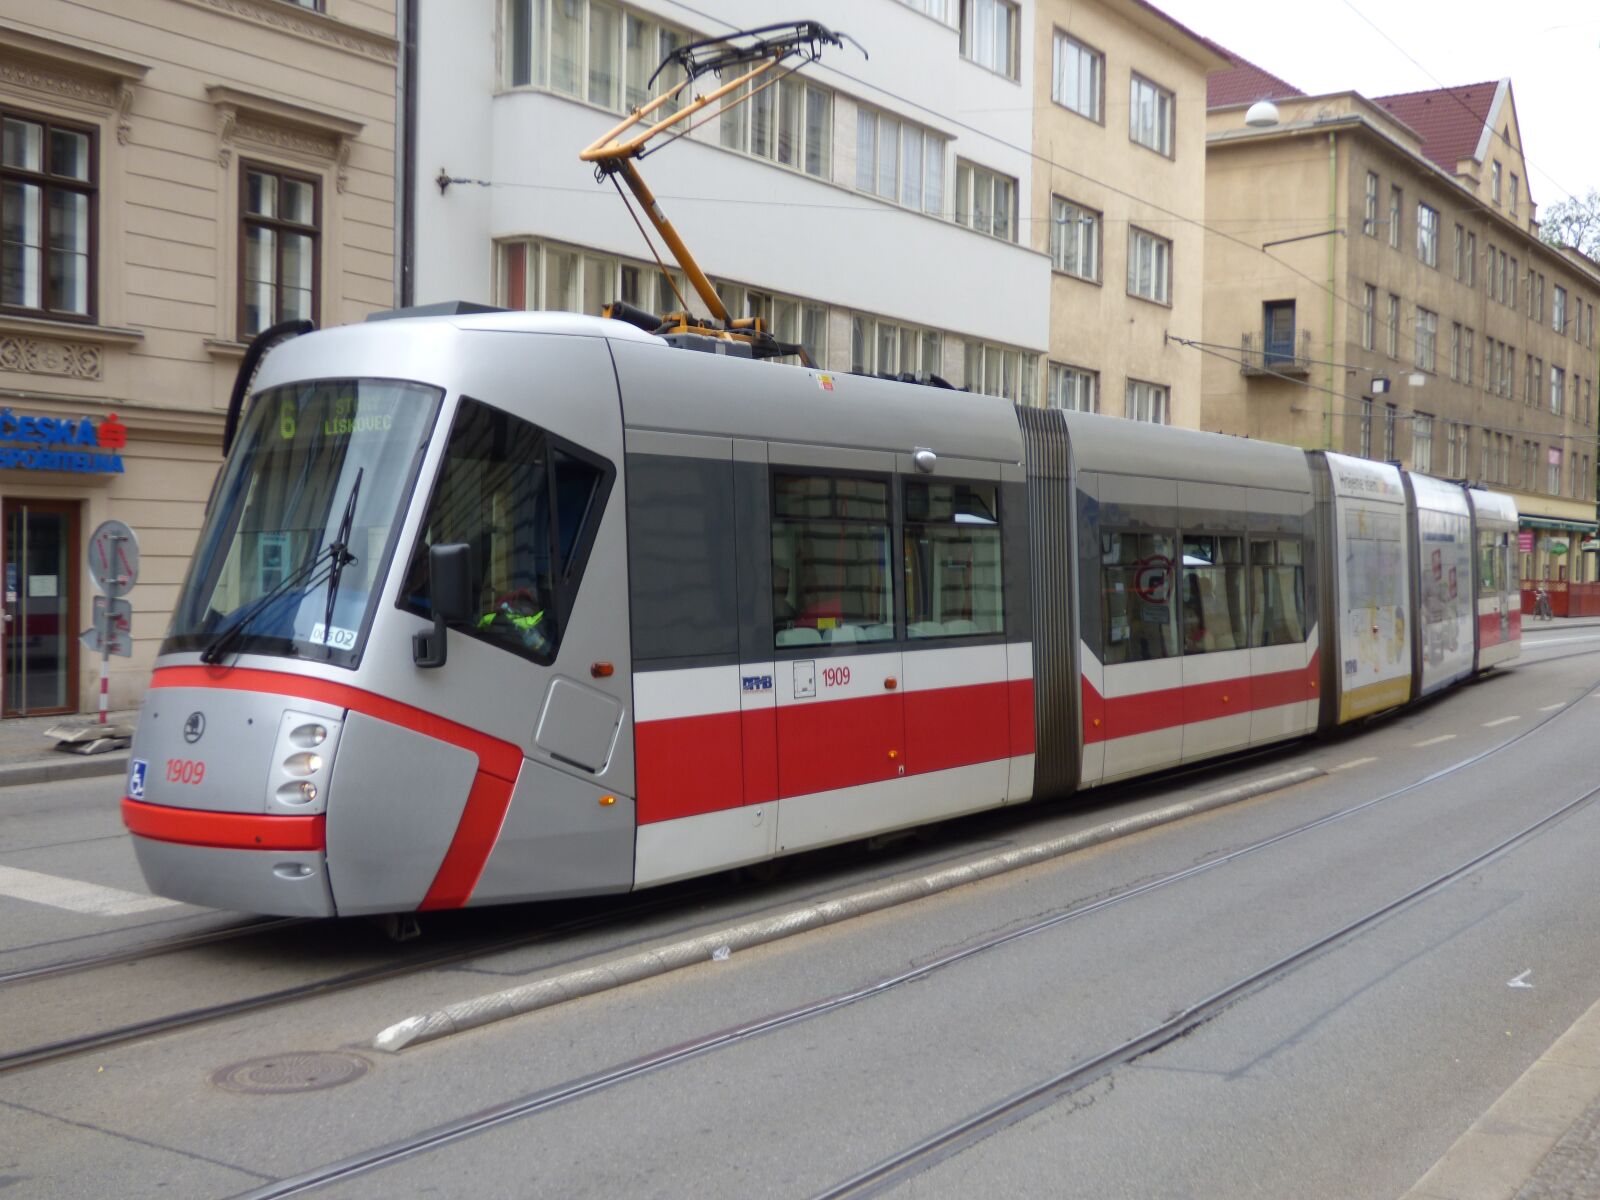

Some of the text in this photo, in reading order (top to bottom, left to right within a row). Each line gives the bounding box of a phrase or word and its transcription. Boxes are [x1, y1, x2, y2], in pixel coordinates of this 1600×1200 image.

[281, 400, 297, 440] 6
[822, 666, 850, 687] 1909
[166, 759, 205, 785] 1909
